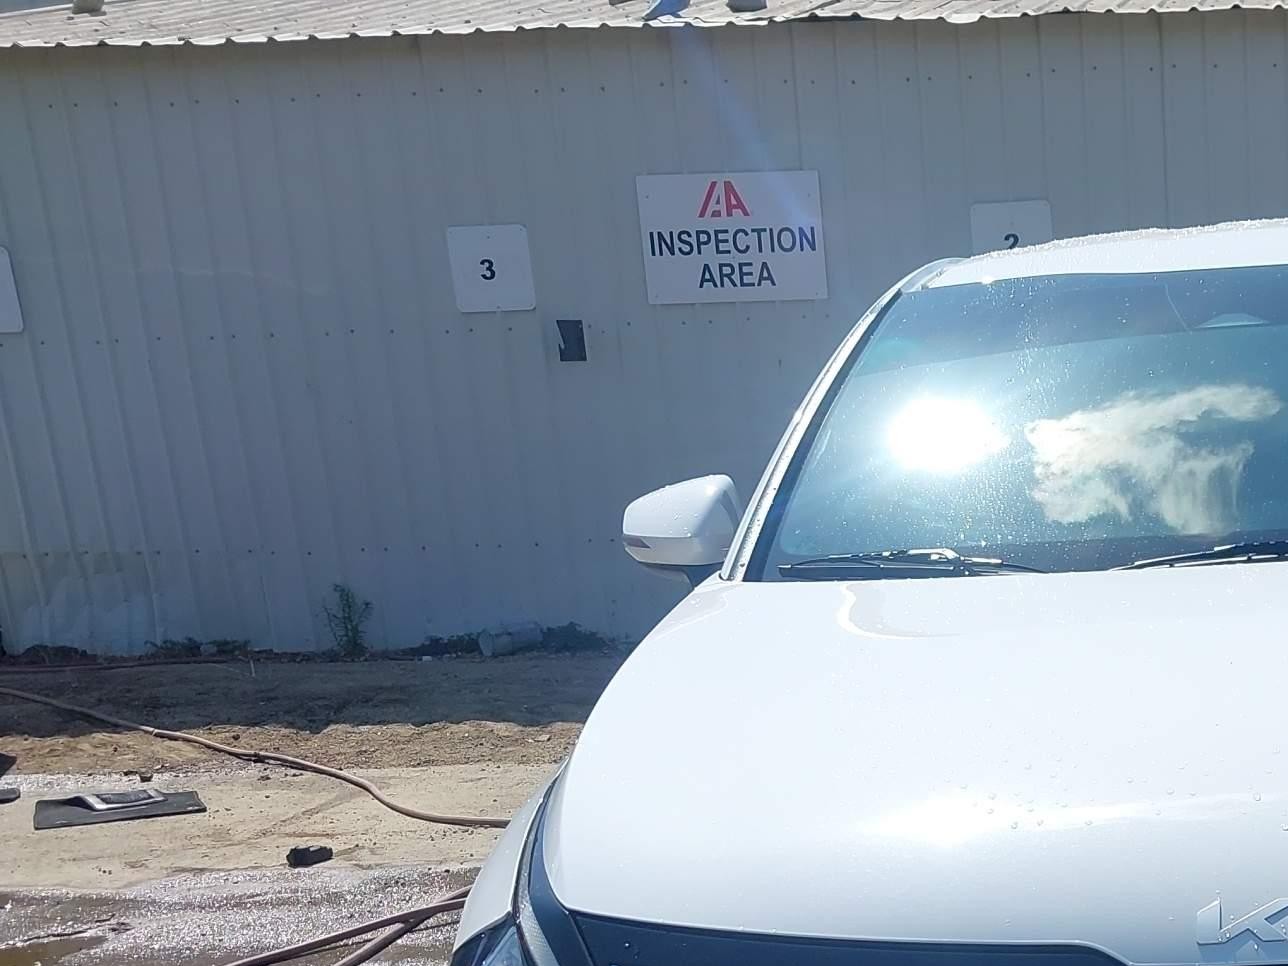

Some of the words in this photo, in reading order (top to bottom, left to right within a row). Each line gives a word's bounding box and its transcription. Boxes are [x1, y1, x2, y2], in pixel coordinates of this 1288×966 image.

[649, 226, 817, 257] INSPECTION
[1004, 233, 1019, 250] 2
[480, 258, 496, 281] 3
[699, 262, 776, 289] AREA
